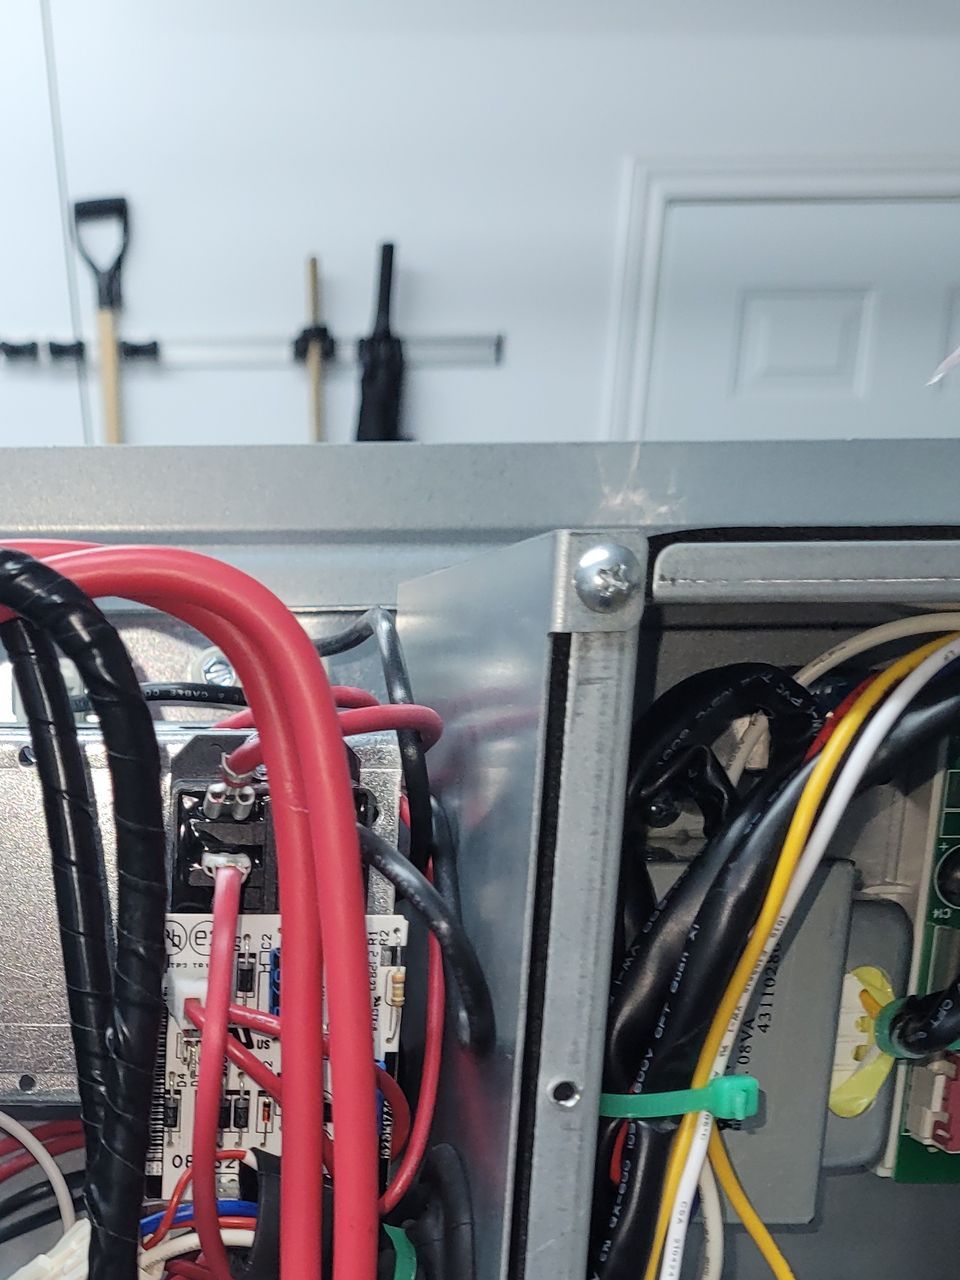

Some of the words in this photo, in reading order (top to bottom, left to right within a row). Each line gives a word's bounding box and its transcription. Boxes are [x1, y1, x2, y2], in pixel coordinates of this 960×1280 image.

[261, 933, 273, 950] C2
[368, 930, 378, 946] R1
[379, 930, 390, 946] R2
[257, 1039, 271, 1050] US
[177, 1073, 187, 1088] D4
